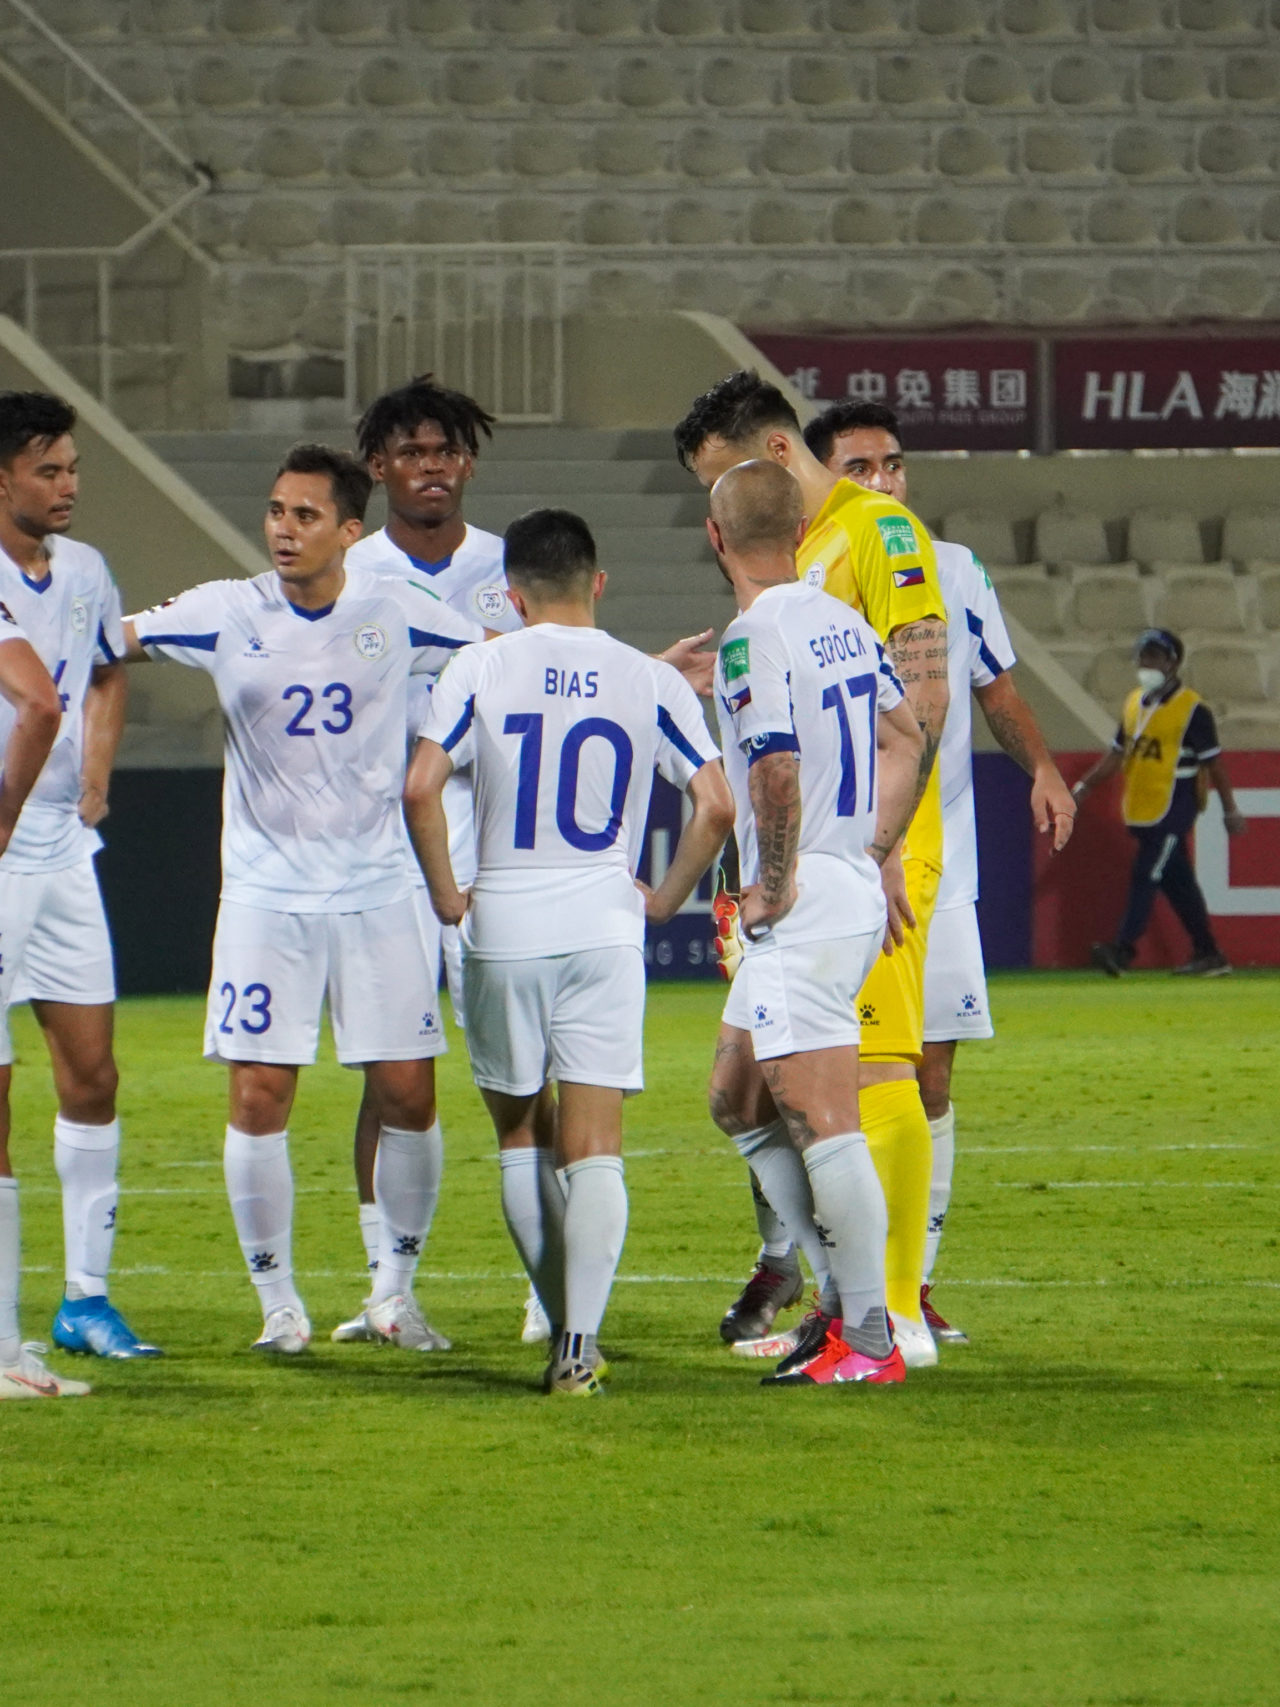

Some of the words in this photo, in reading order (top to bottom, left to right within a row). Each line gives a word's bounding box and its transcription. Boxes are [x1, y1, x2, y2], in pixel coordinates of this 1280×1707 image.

[847, 368, 1028, 408] 中免集团
[1081, 371, 1203, 420] HLA
[282, 682, 353, 736] 23
[544, 667, 599, 698] BIAS
[822, 672, 879, 817] 17
[503, 713, 634, 853] 10
[220, 981, 272, 1036] 23
